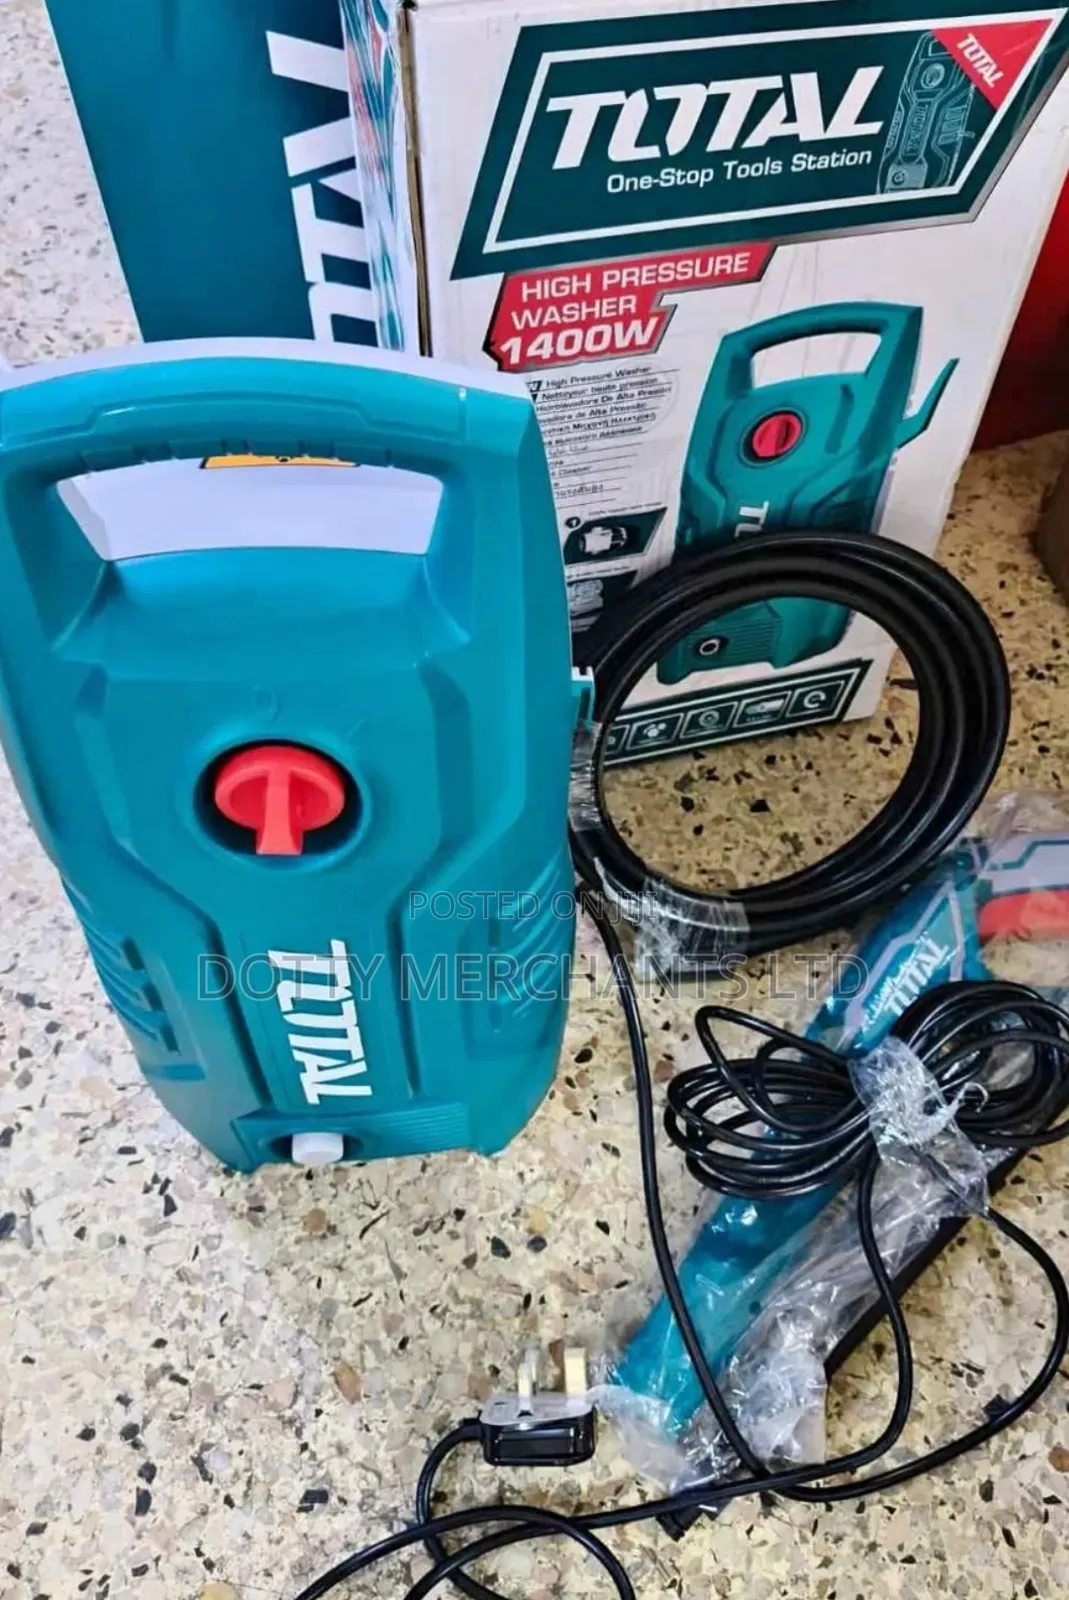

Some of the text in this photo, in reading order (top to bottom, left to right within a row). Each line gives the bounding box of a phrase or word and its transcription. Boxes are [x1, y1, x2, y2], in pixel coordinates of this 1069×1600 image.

[956, 33, 1004, 88] TOTAL
[546, 66, 884, 169] TOTAL
[607, 150, 872, 193] One-Stop Tools Station
[522, 252, 750, 302] HIGH PRESSURE
[511, 295, 637, 331] WASHER
[500, 316, 659, 365] 1400W
[546, 366, 651, 389] High Pressure Washer
[884, 937, 950, 1016] TOTAL
[268, 938, 373, 1105] TOTAL
